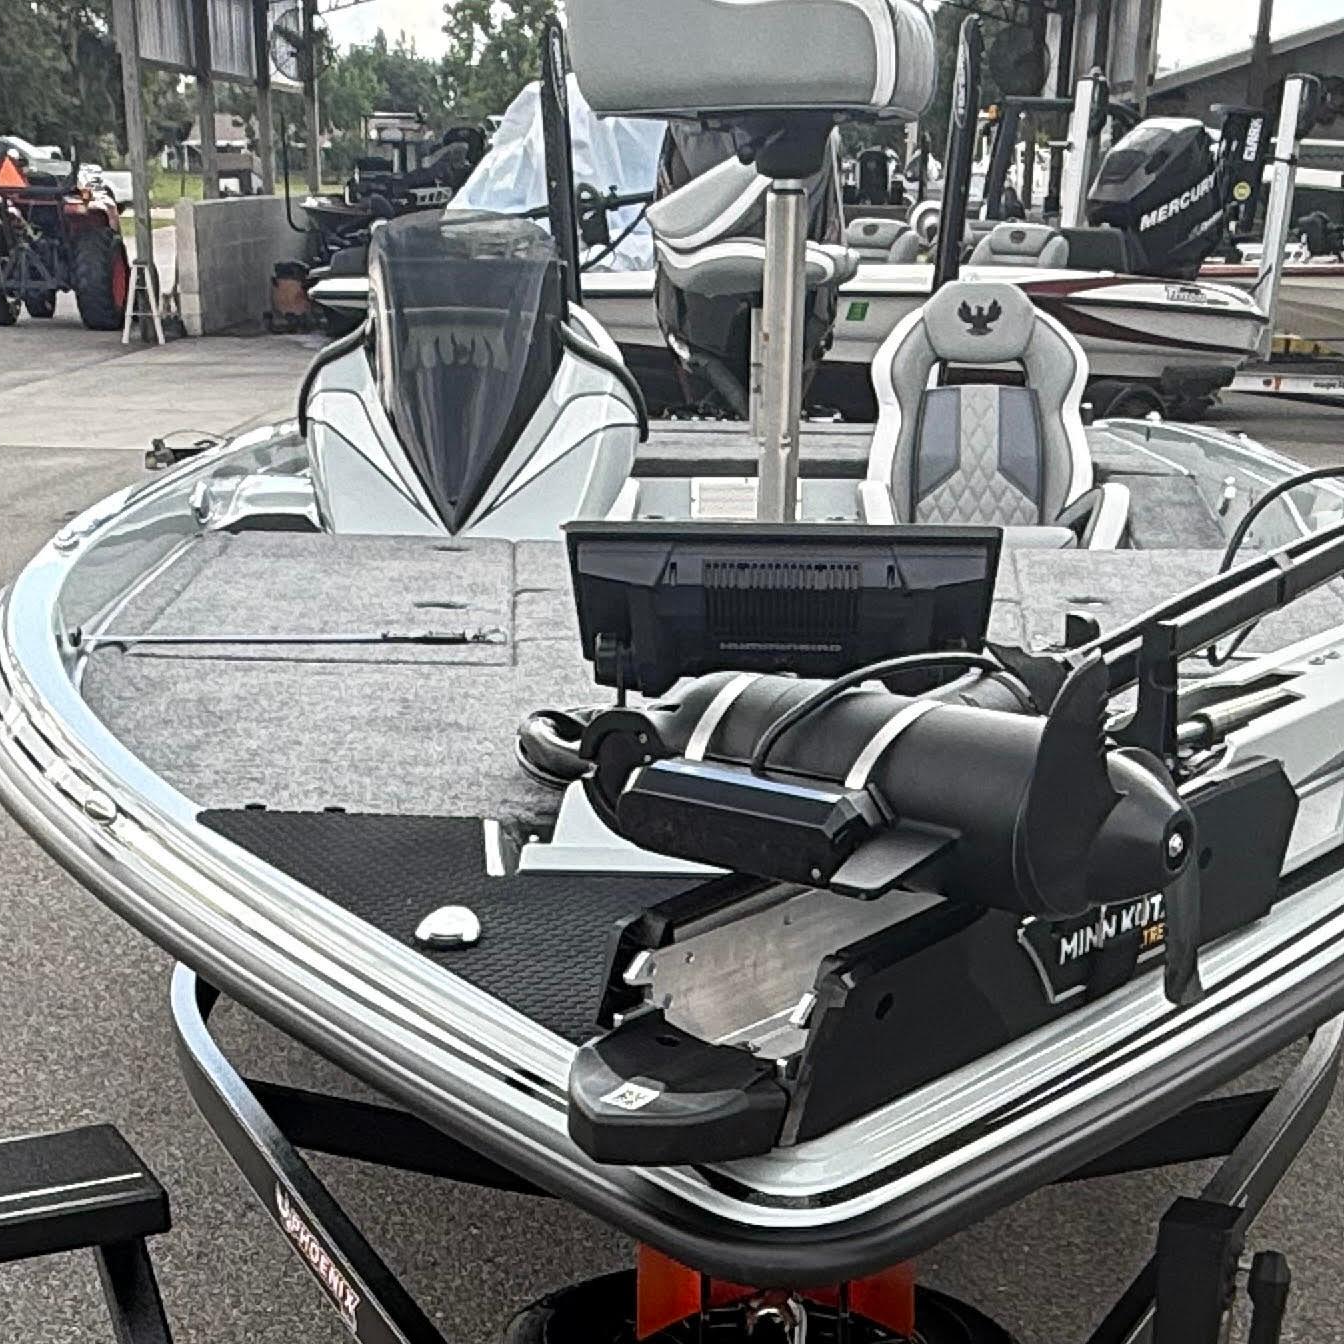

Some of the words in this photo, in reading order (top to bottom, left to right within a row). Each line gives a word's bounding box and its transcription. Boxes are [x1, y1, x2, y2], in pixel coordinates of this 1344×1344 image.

[1140, 170, 1219, 232] MERCURY
[1059, 912, 1117, 966] MINN
[1121, 892, 1165, 932] KOT
[286, 1208, 360, 1334] PHOENIX
